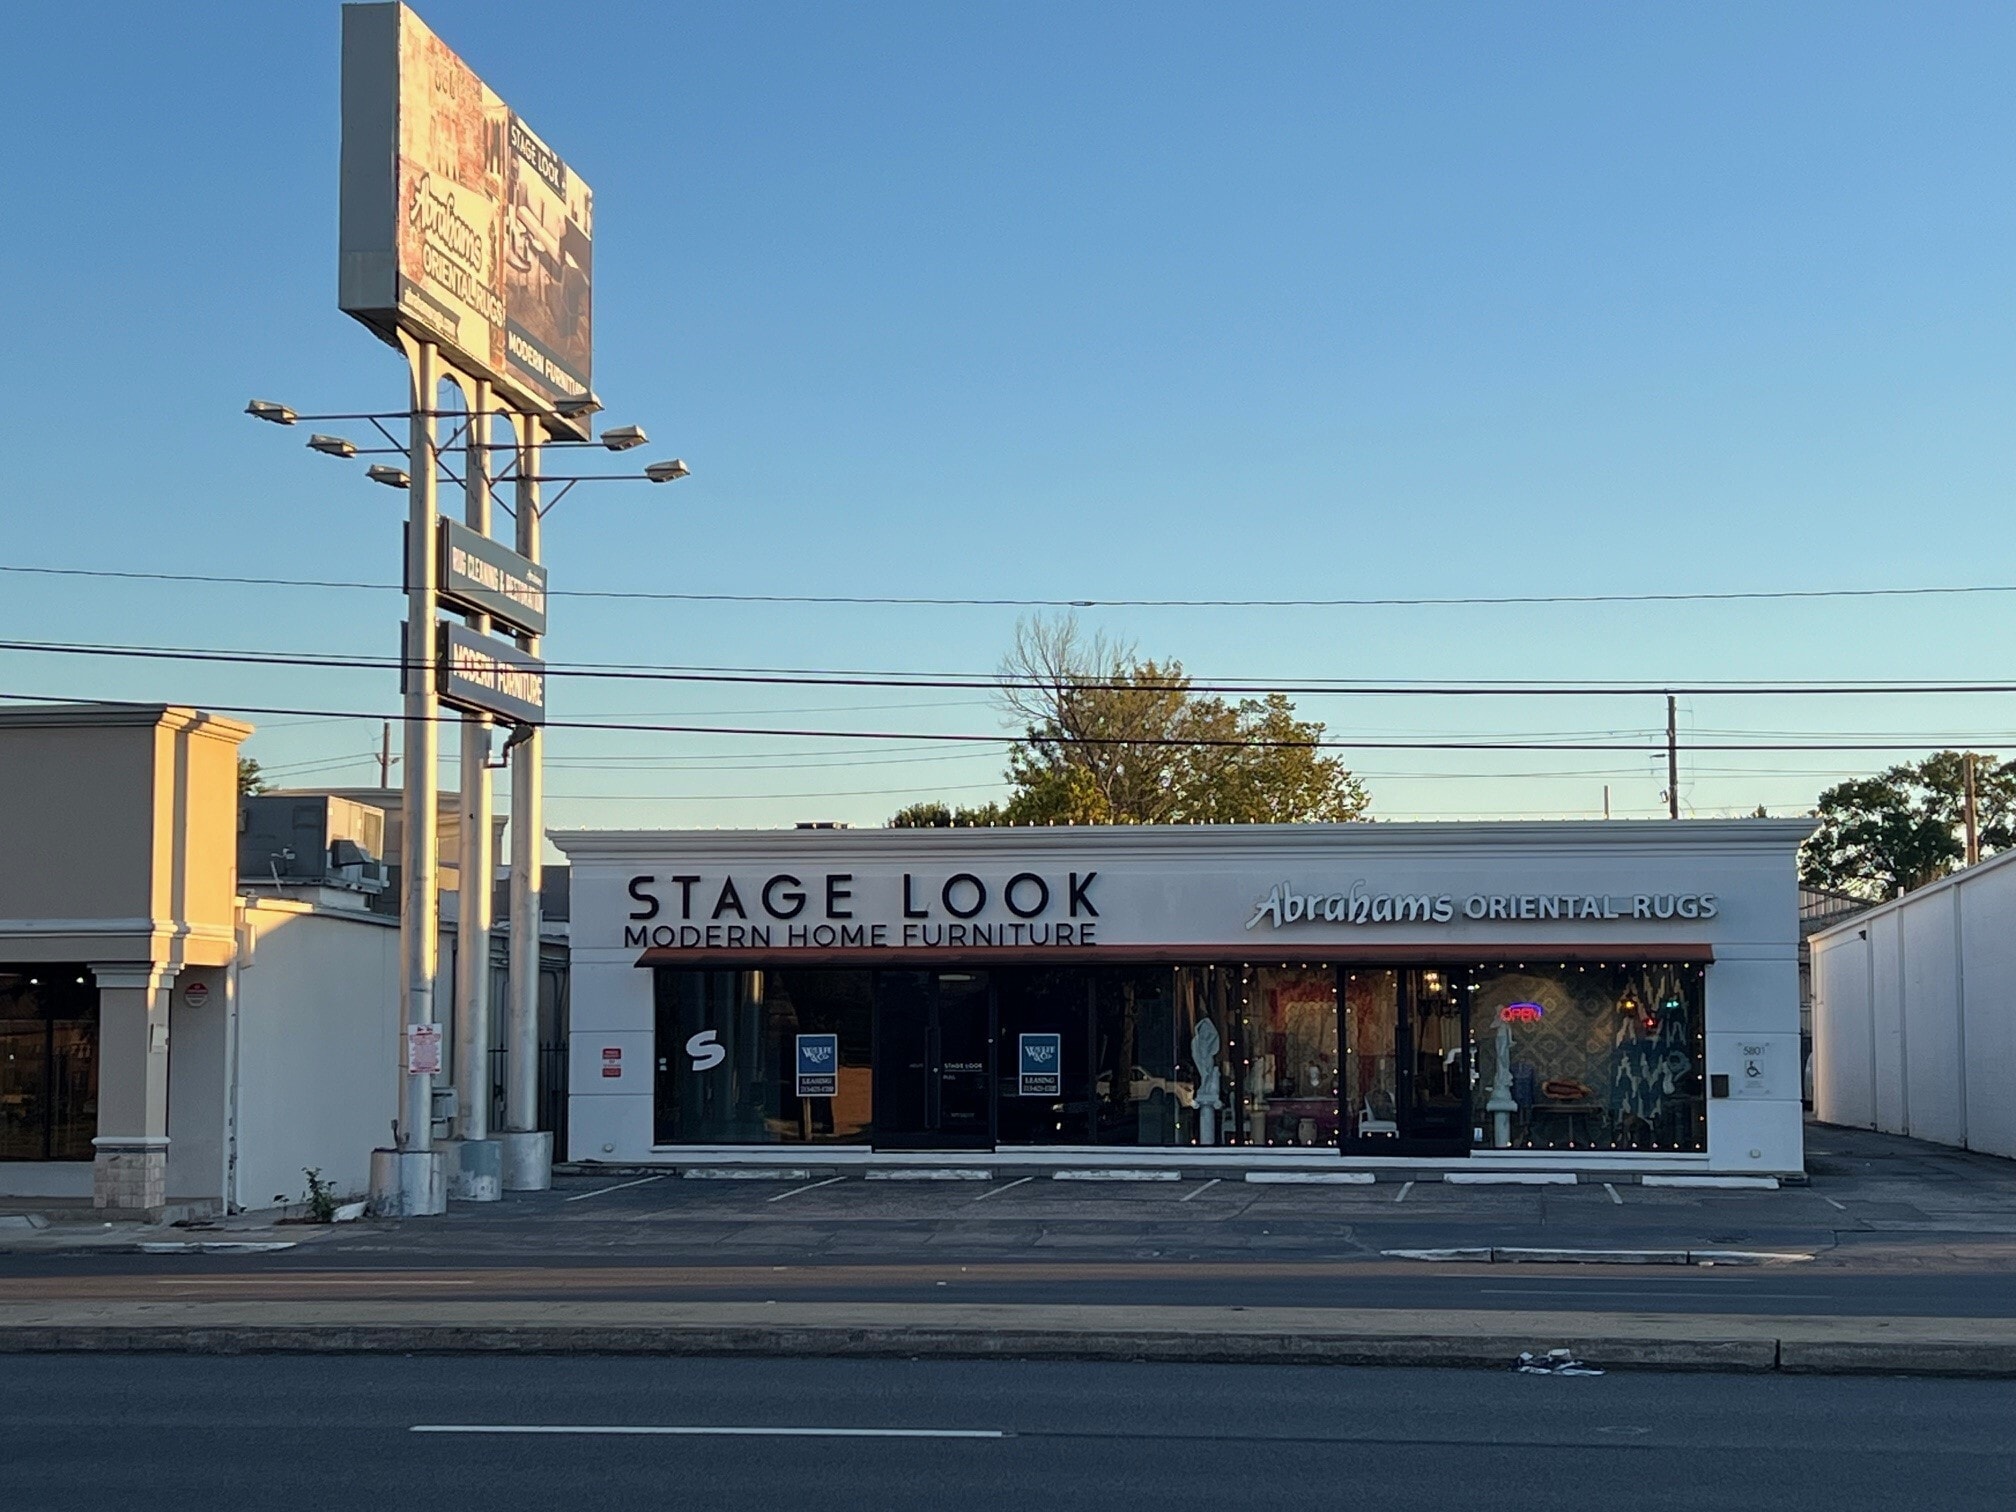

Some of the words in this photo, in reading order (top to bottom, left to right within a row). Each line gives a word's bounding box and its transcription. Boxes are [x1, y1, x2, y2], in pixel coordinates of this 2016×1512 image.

[511, 125, 536, 166] STAGE
[538, 151, 559, 188] LOOK
[409, 172, 482, 273] Abrahams
[423, 242, 476, 306] ORIENTAL
[475, 280, 505, 327] RUGS
[508, 330, 544, 375] MODERN
[453, 643, 495, 690] MODERN
[497, 661, 543, 707] FURNITURE
[628, 874, 854, 920] STAGE
[903, 872, 1099, 919] LOOK
[1245, 878, 1454, 930] Abrahams
[1464, 893, 1619, 920] ORIENTAL
[1632, 893, 1719, 919] RUGS
[624, 924, 770, 948] MODERN
[788, 924, 887, 947] HOME
[903, 923, 1097, 947] FURNITURE
[1501, 1007, 1540, 1023] OPEN
[686, 1029, 726, 1071] S
